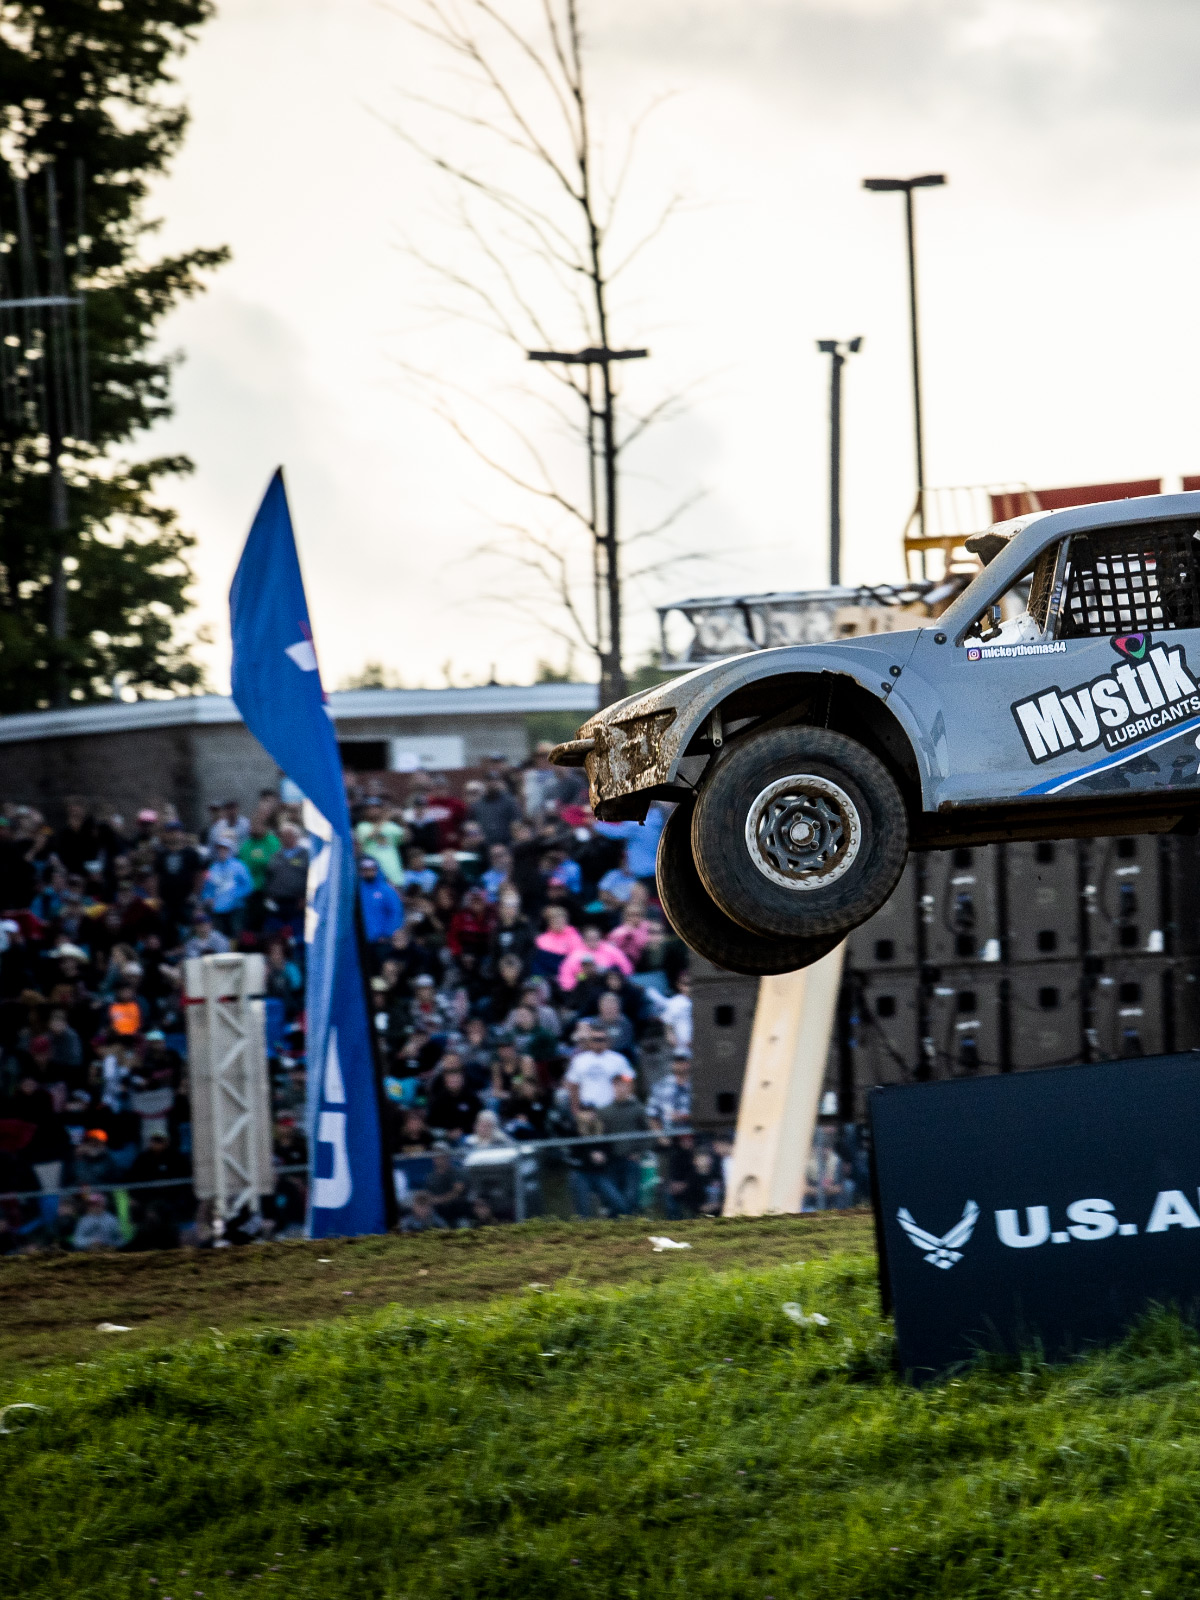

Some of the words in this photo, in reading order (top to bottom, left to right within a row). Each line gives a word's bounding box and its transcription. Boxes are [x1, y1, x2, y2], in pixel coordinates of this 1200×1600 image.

[981, 641, 1067, 659] mickeythomas44
[1016, 647, 1198, 760] Mystik
[994, 1198, 1139, 1249] U.S.
